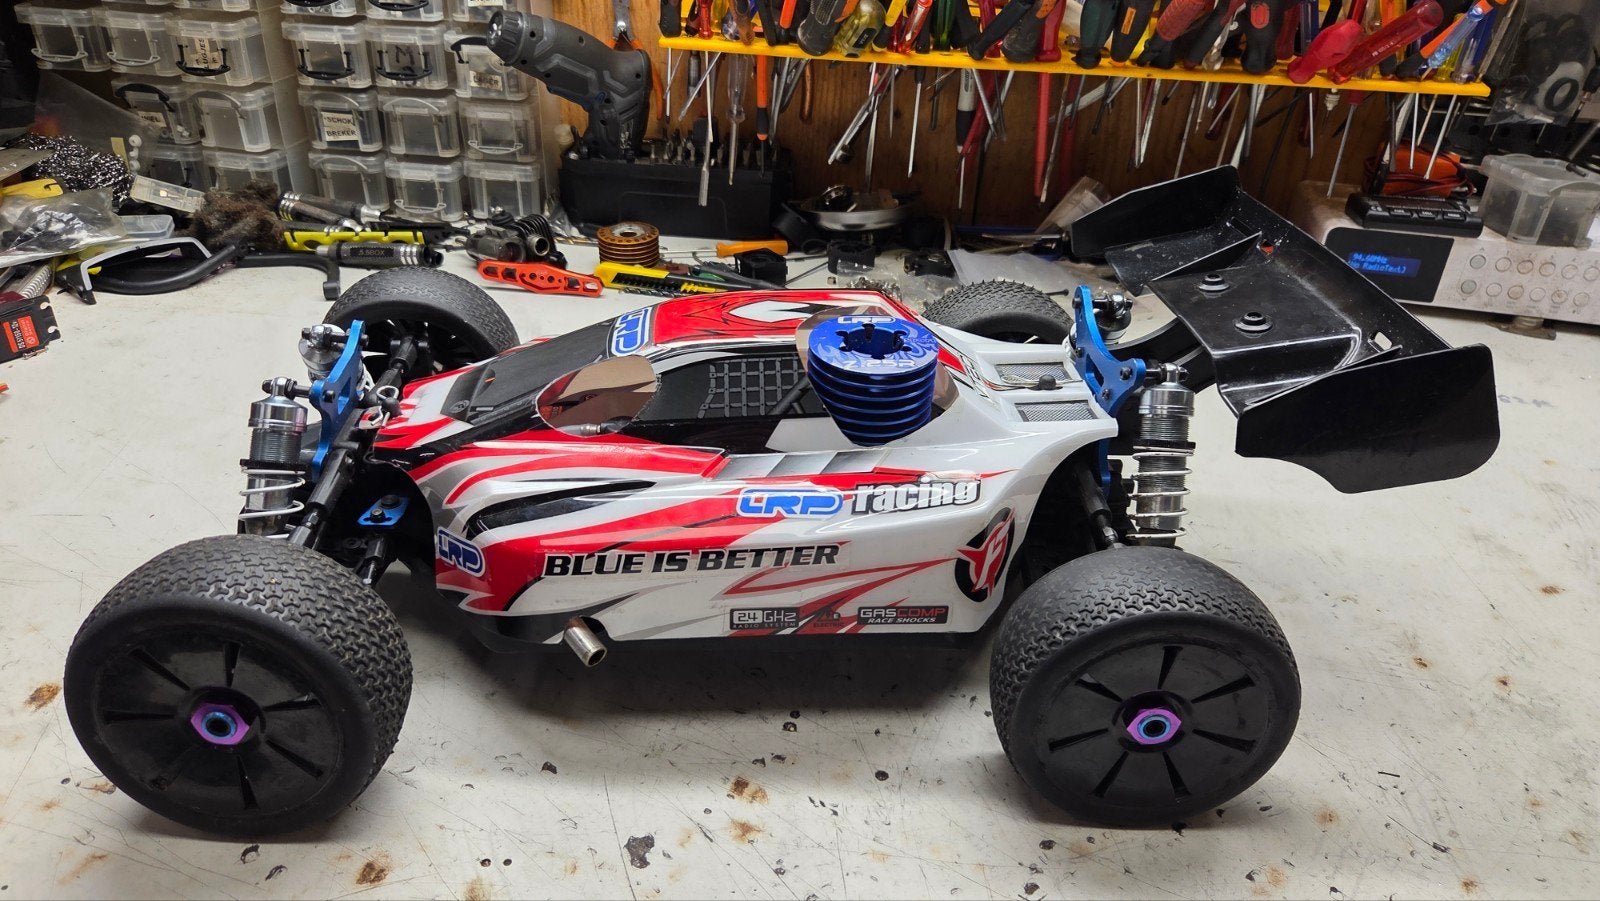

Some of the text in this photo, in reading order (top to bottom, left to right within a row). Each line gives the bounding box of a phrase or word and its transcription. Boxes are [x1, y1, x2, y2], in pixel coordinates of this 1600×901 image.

[738, 476, 982, 517] LRP racing
[437, 528, 485, 576] LRP
[544, 544, 840, 577] BLUE IS BETTER
[860, 608, 946, 618] GASCOMP
